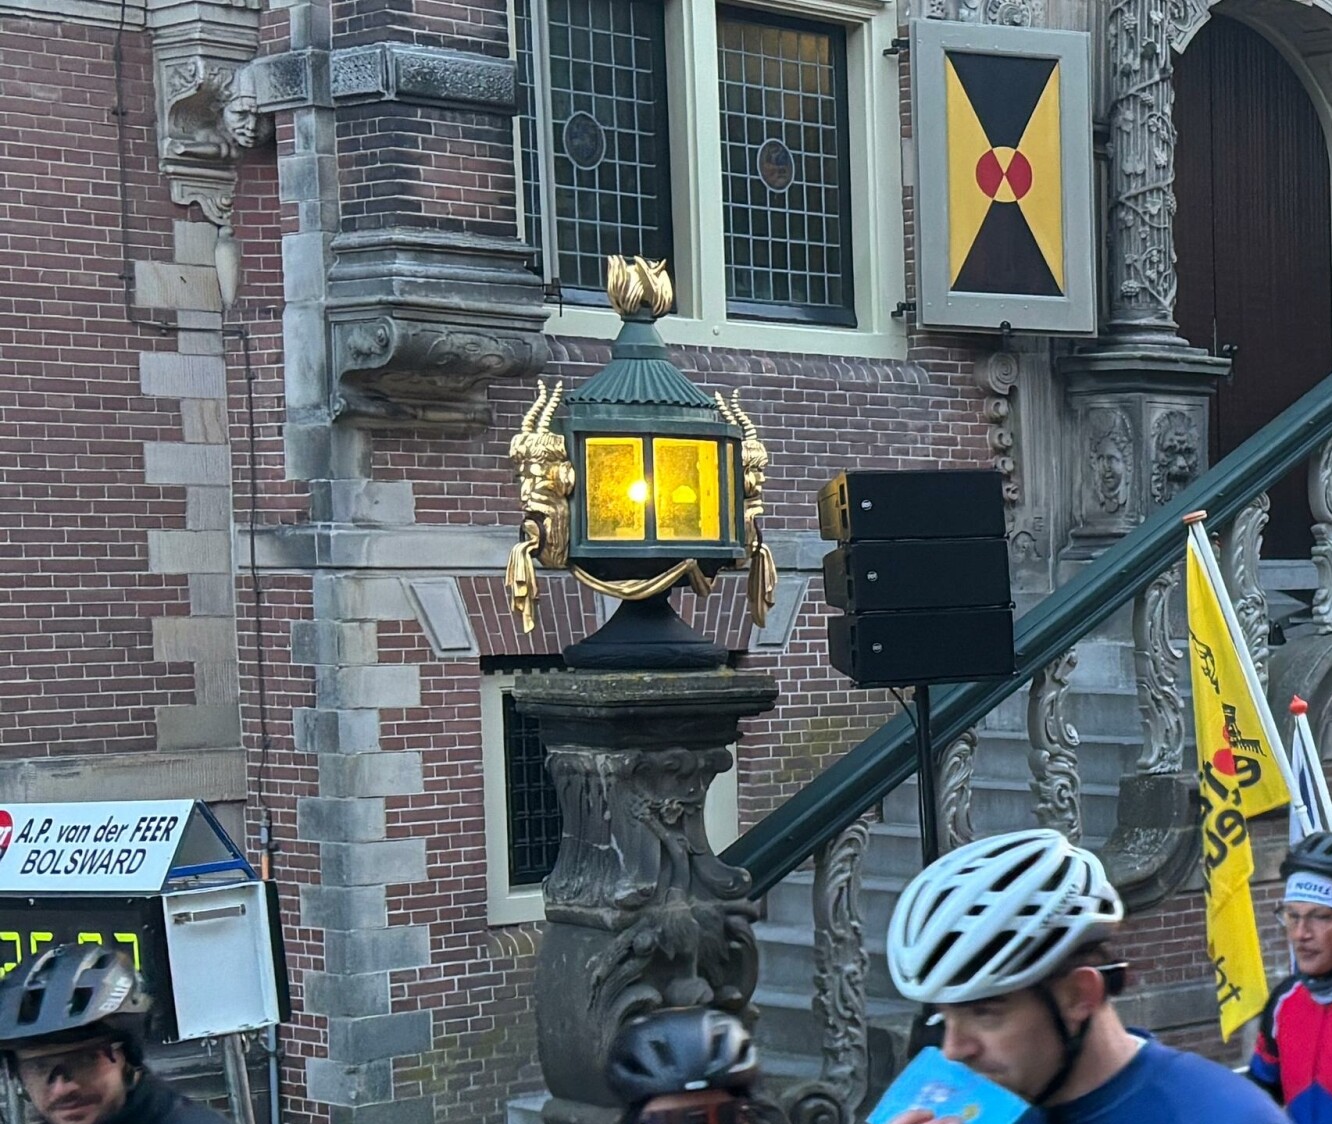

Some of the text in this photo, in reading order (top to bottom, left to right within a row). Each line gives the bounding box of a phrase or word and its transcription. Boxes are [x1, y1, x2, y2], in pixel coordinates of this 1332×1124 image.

[15, 818, 54, 844] A.P.
[57, 825, 92, 844] van
[94, 815, 129, 843] der
[129, 816, 179, 843] FEER
[20, 848, 147, 875] BOLSWARD
